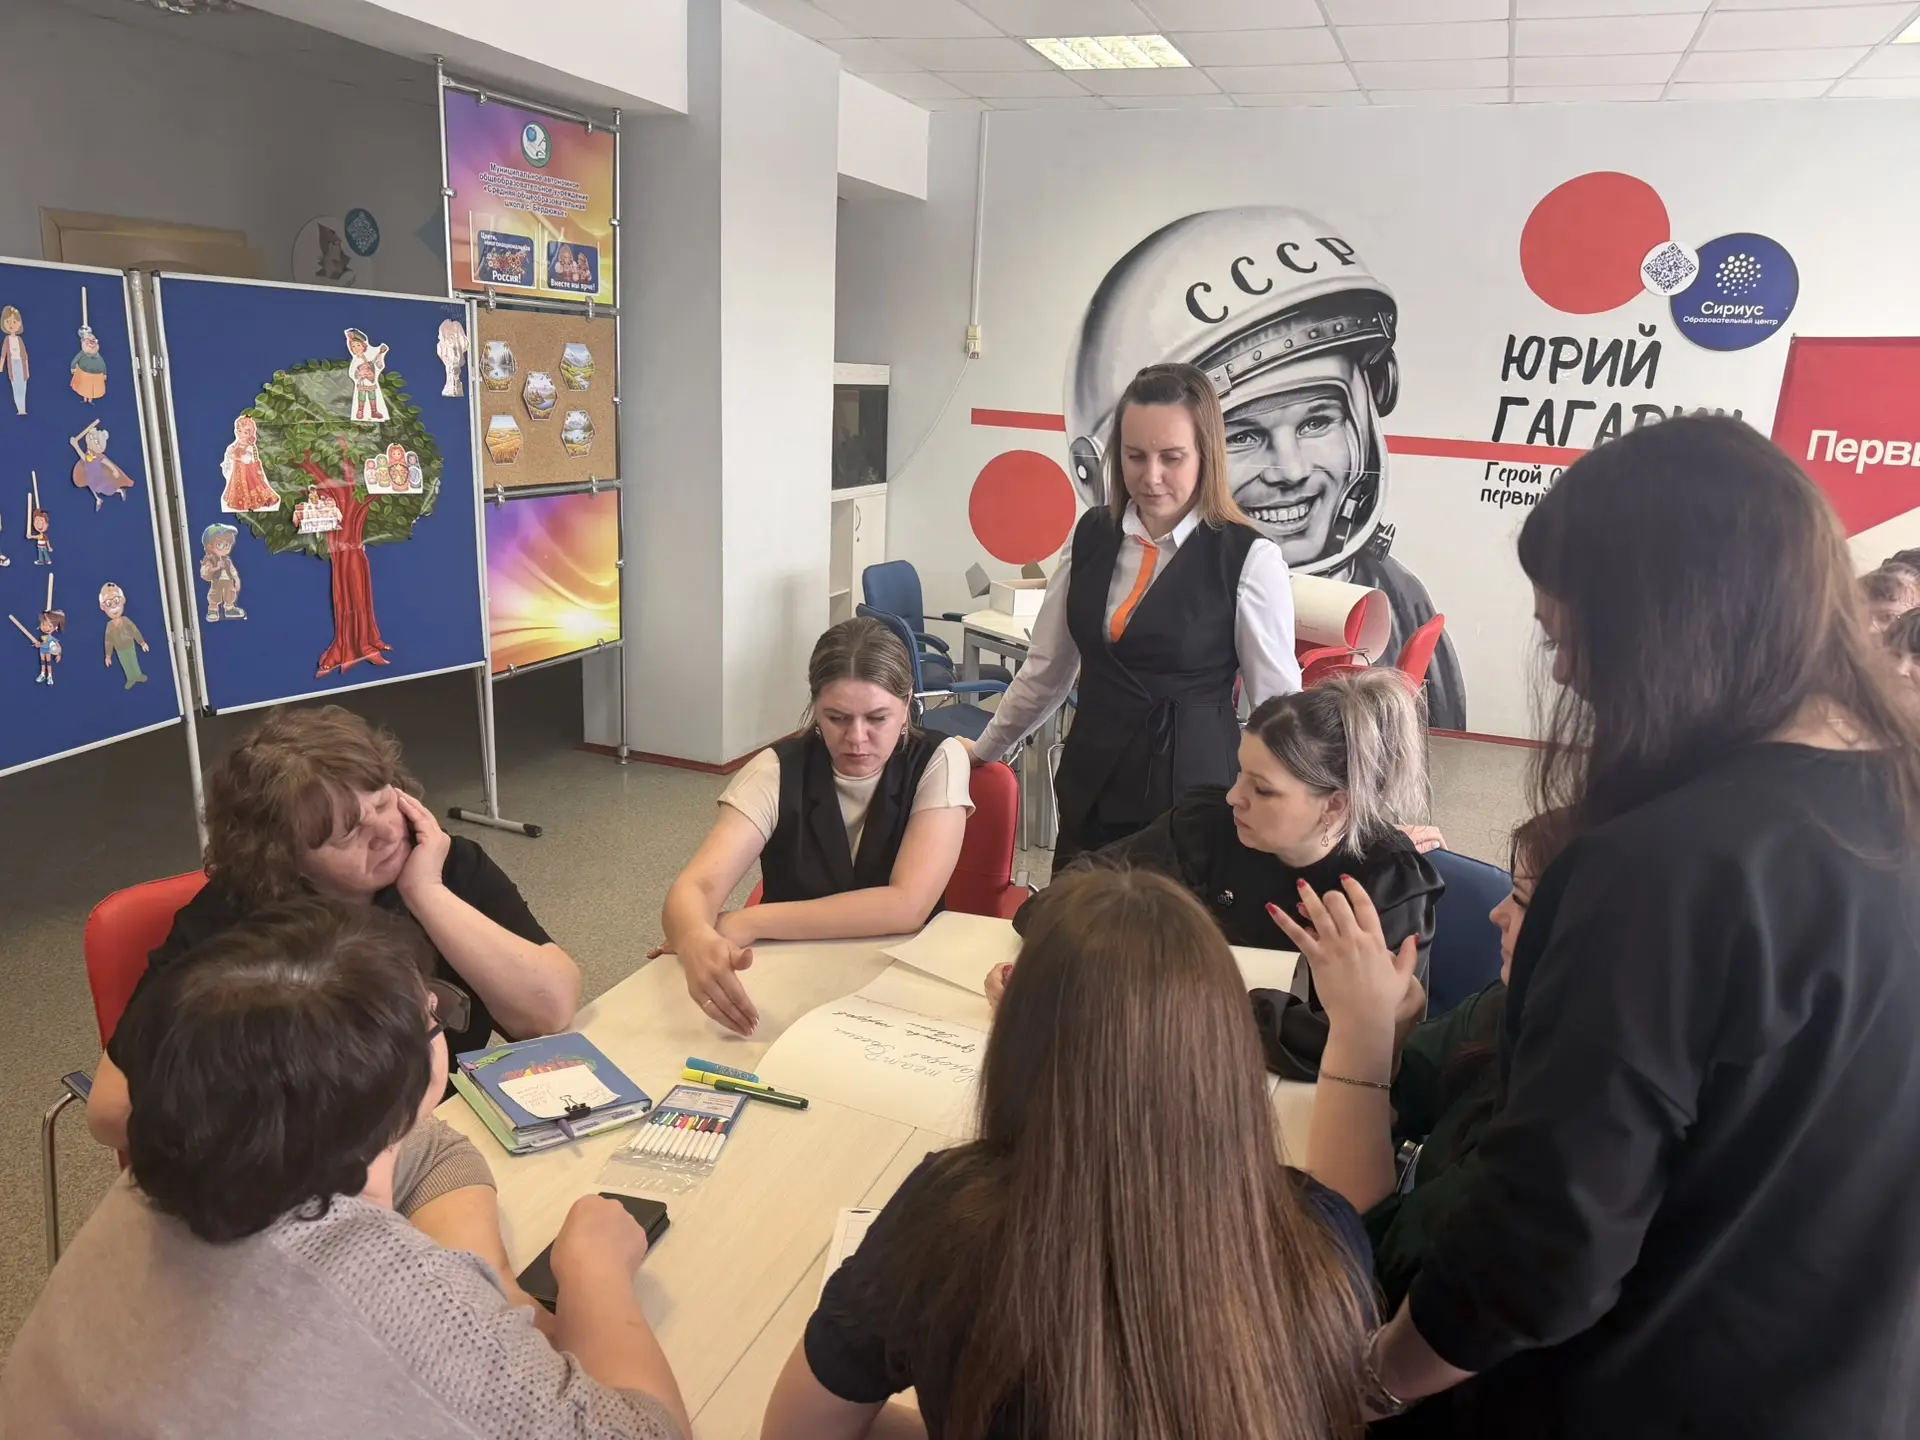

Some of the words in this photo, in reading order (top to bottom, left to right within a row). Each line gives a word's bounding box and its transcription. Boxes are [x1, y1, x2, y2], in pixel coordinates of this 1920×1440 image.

[490, 163, 542, 180] Муниципальное
[544, 176, 580, 189] автономное
[479, 173, 552, 193] общеобразовательное
[554, 189, 589, 201] учреждение
[504, 200, 524, 210] школа
[517, 192, 586, 210] общеобразовательная
[492, 270, 522, 283] Россия!
[550, 278, 570, 288] Вместе
[581, 283, 596, 291] ярче!
[1185, 237, 1356, 324] СССР
[1700, 301, 1764, 318] Сириус
[1682, 315, 1753, 325] Образовательный
[1500, 323, 1662, 389] ЮРИЙ
[1484, 461, 1543, 487] Герой
